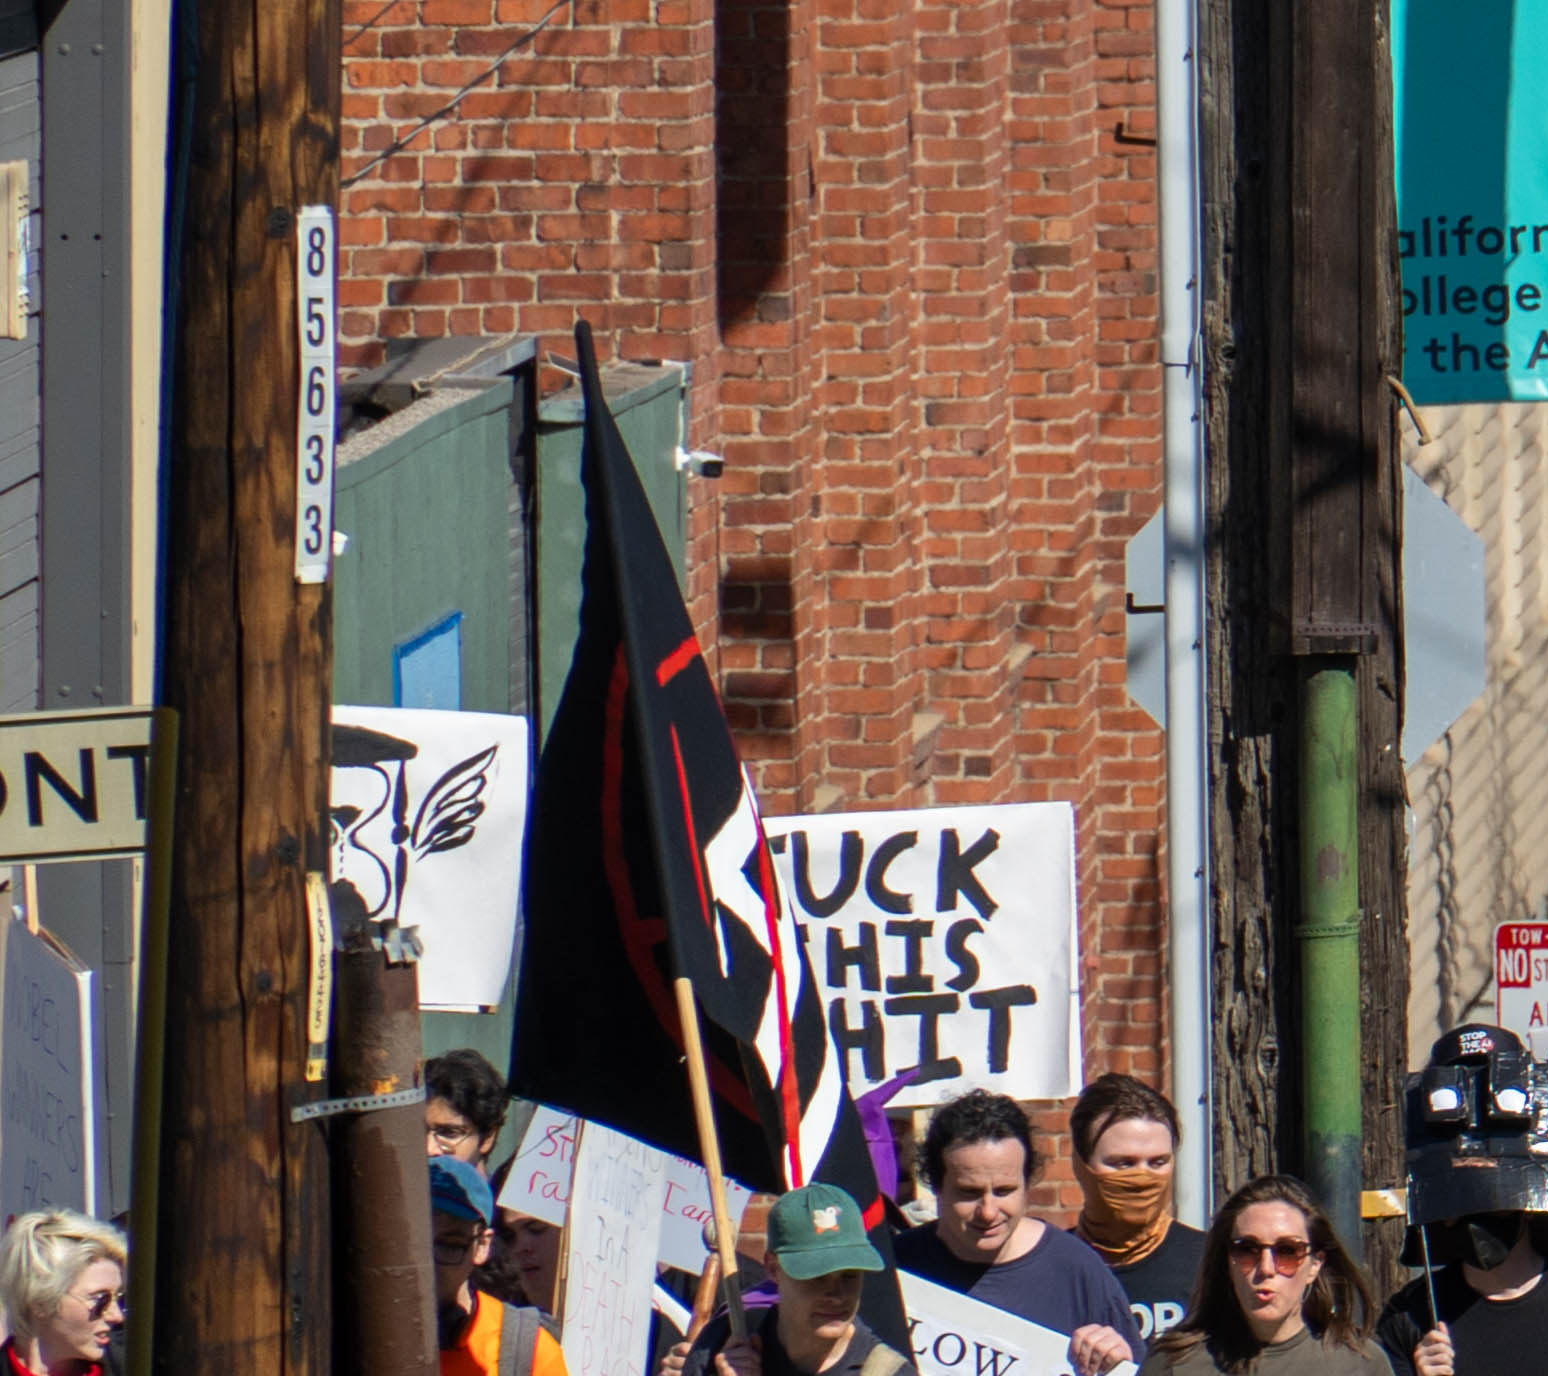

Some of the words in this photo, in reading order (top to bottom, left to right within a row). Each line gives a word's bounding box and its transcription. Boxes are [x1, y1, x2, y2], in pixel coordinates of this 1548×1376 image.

[1402, 275, 1542, 326] ollege
[1422, 332, 1511, 373] the
[304, 226, 327, 556] 85633
[0, 744, 152, 827] NT
[768, 827, 1001, 920] UCK
[797, 918, 986, 995] HIS
[1500, 948, 1529, 984] NO
[828, 984, 1038, 1086] HIT
[540, 1124, 576, 1165] ST
[528, 1170, 570, 1204] ra
[1129, 1301, 1185, 1341] OP
